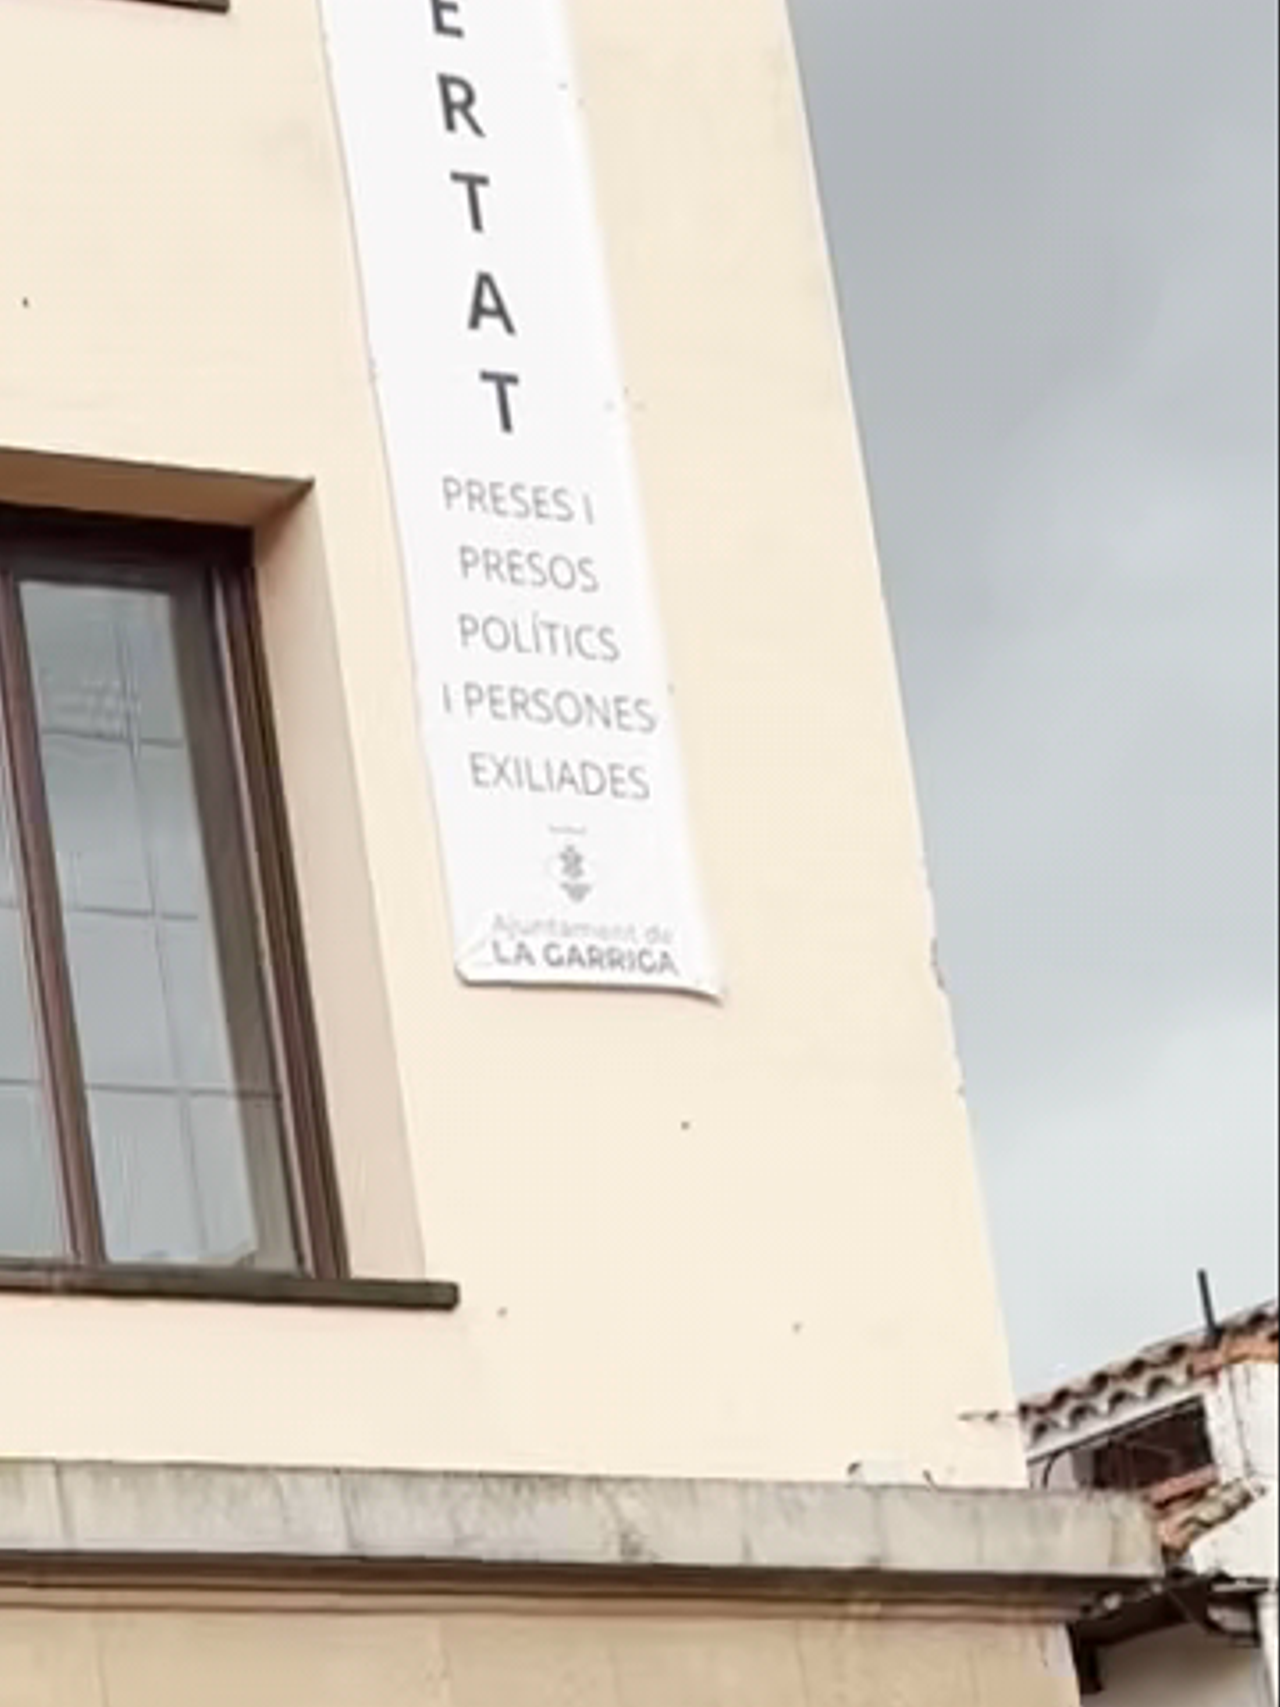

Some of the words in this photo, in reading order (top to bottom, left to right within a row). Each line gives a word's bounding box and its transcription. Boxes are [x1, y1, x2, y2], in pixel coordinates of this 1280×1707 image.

[442, 475, 574, 524] PRESES
[582, 492, 595, 525] I
[459, 544, 600, 594] PRESOS
[458, 611, 621, 662] POLÍTICS
[442, 684, 453, 714] I
[464, 683, 657, 734] PERSONES
[469, 751, 651, 801] EXILIADES
[493, 914, 637, 944] Ajuntament
[645, 924, 675, 944] de
[492, 941, 535, 966] LA
[542, 943, 679, 974] GARRIGA
